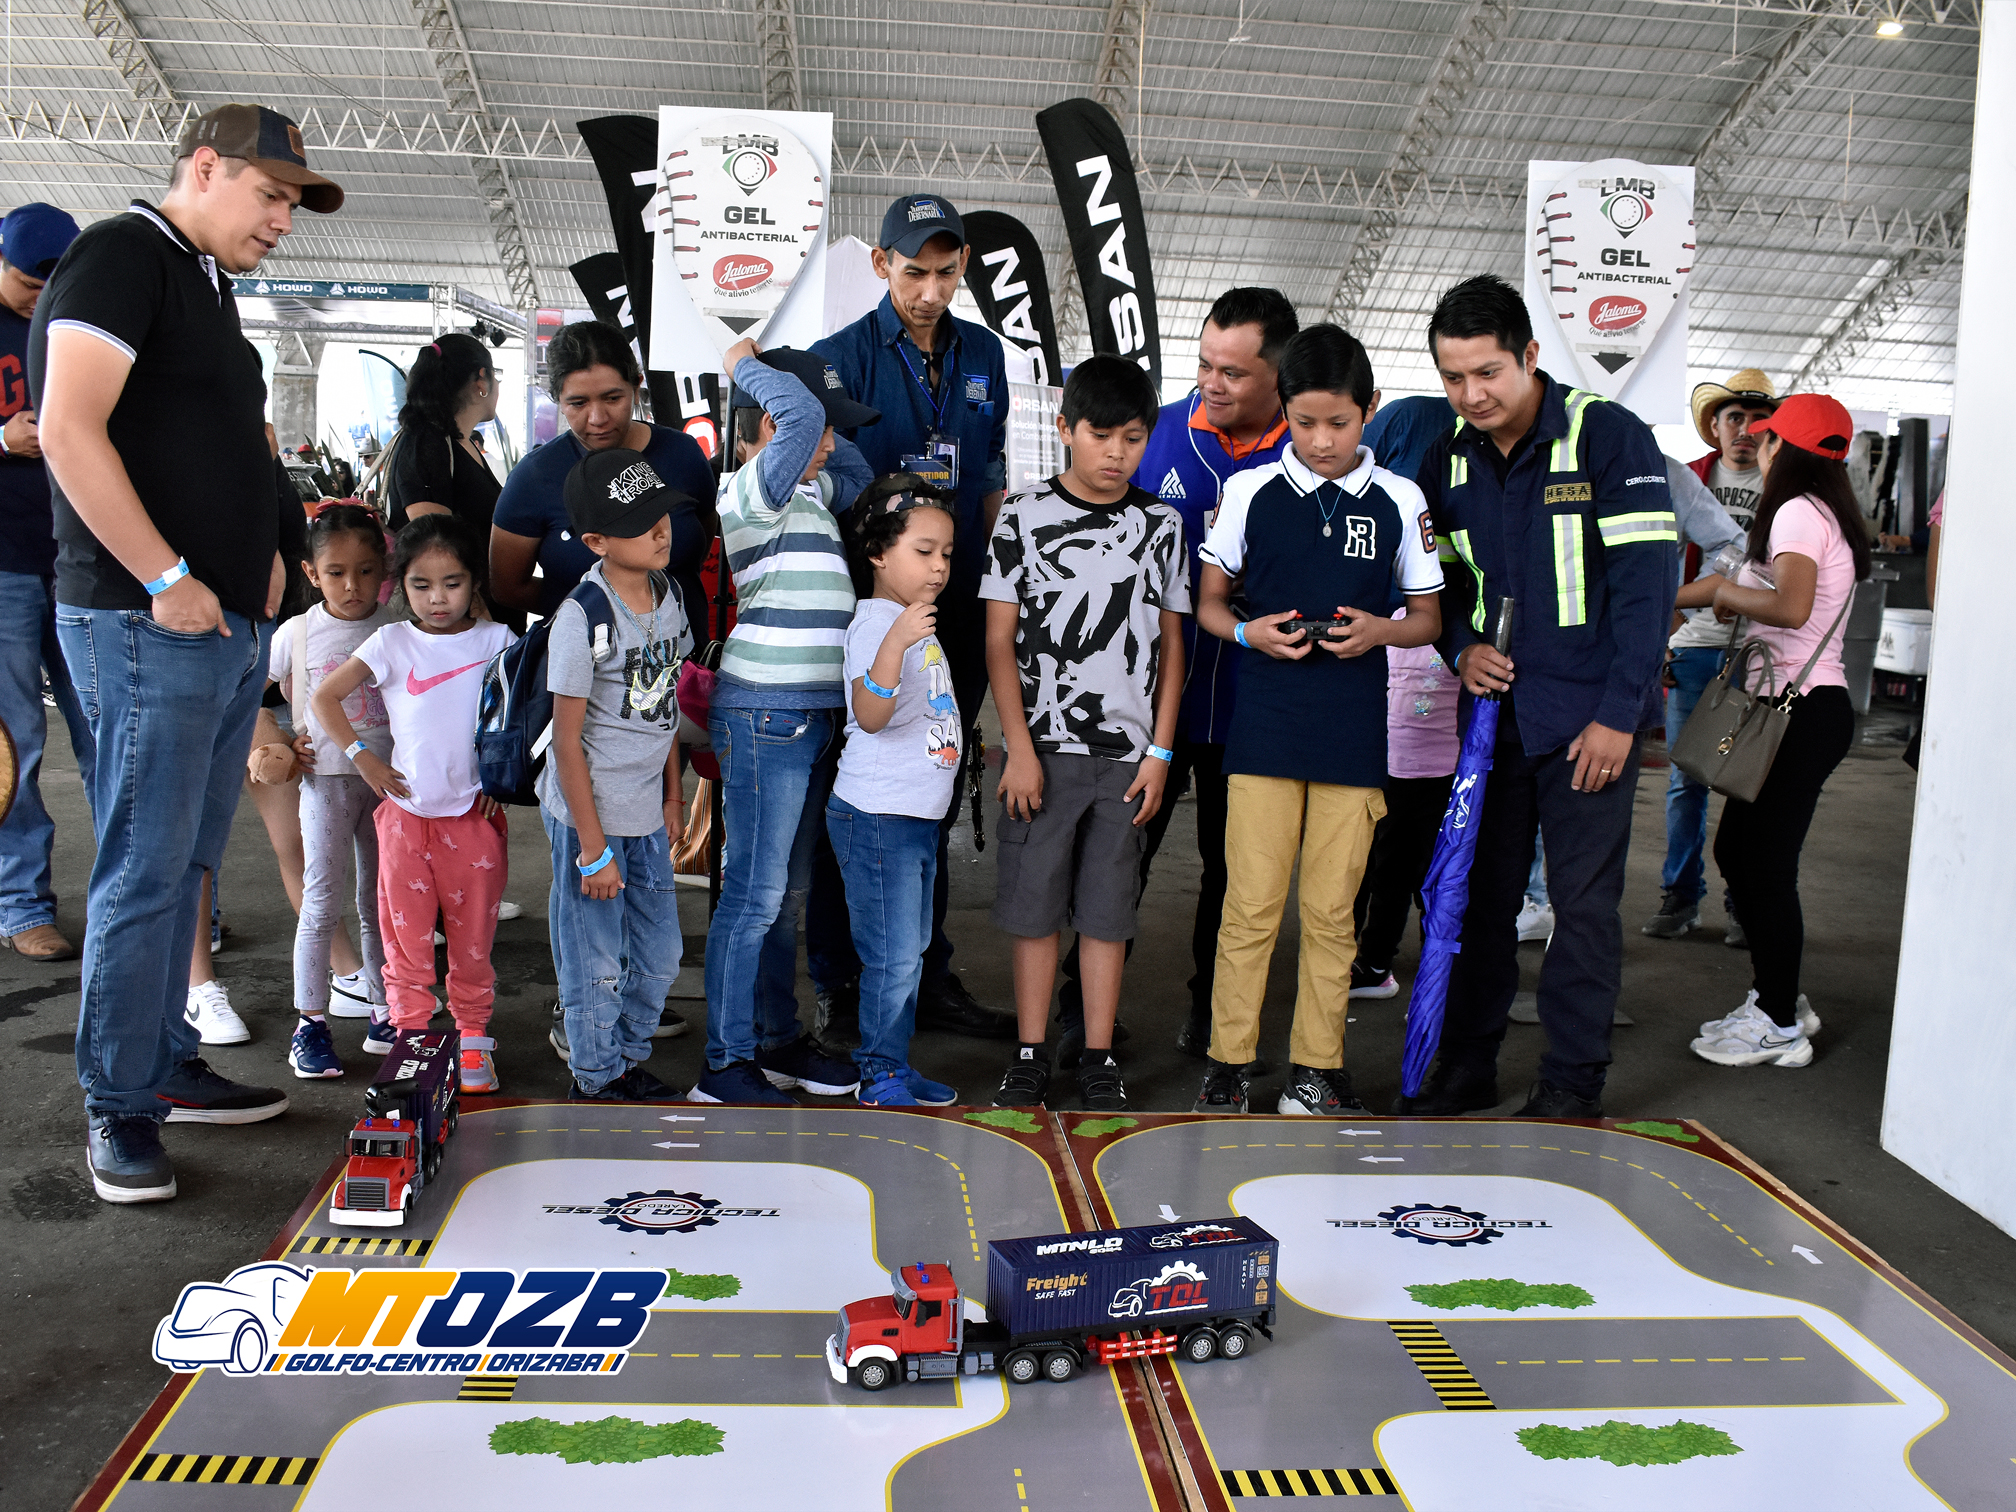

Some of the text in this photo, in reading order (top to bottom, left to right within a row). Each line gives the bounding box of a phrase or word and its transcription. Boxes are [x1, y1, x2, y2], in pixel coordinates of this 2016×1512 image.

[1600, 177, 1656, 200] LMB
[724, 205, 776, 226] GEL
[700, 230, 799, 243] ANTIBACTERIAL
[1075, 154, 1151, 371] SAN
[1600, 247, 1651, 268] GEL
[719, 260, 769, 284] Jaloma
[1577, 272, 1672, 285] ANTIBACTERIAL
[272, 283, 388, 295] HOWO HOWO
[728, 289, 749, 298] alivio
[1594, 302, 1643, 325] Jaloma
[1545, 485, 1589, 500] HESA
[1344, 515, 1376, 560] R
[1417, 509, 1437, 554] 6
[541, 1205, 782, 1217] TECNICA DIESEL
[1326, 1220, 1553, 1229] TECNICA DIESEL
[1026, 1271, 1088, 1291] Freight
[1034, 1288, 1077, 1300] SAFE FAST
